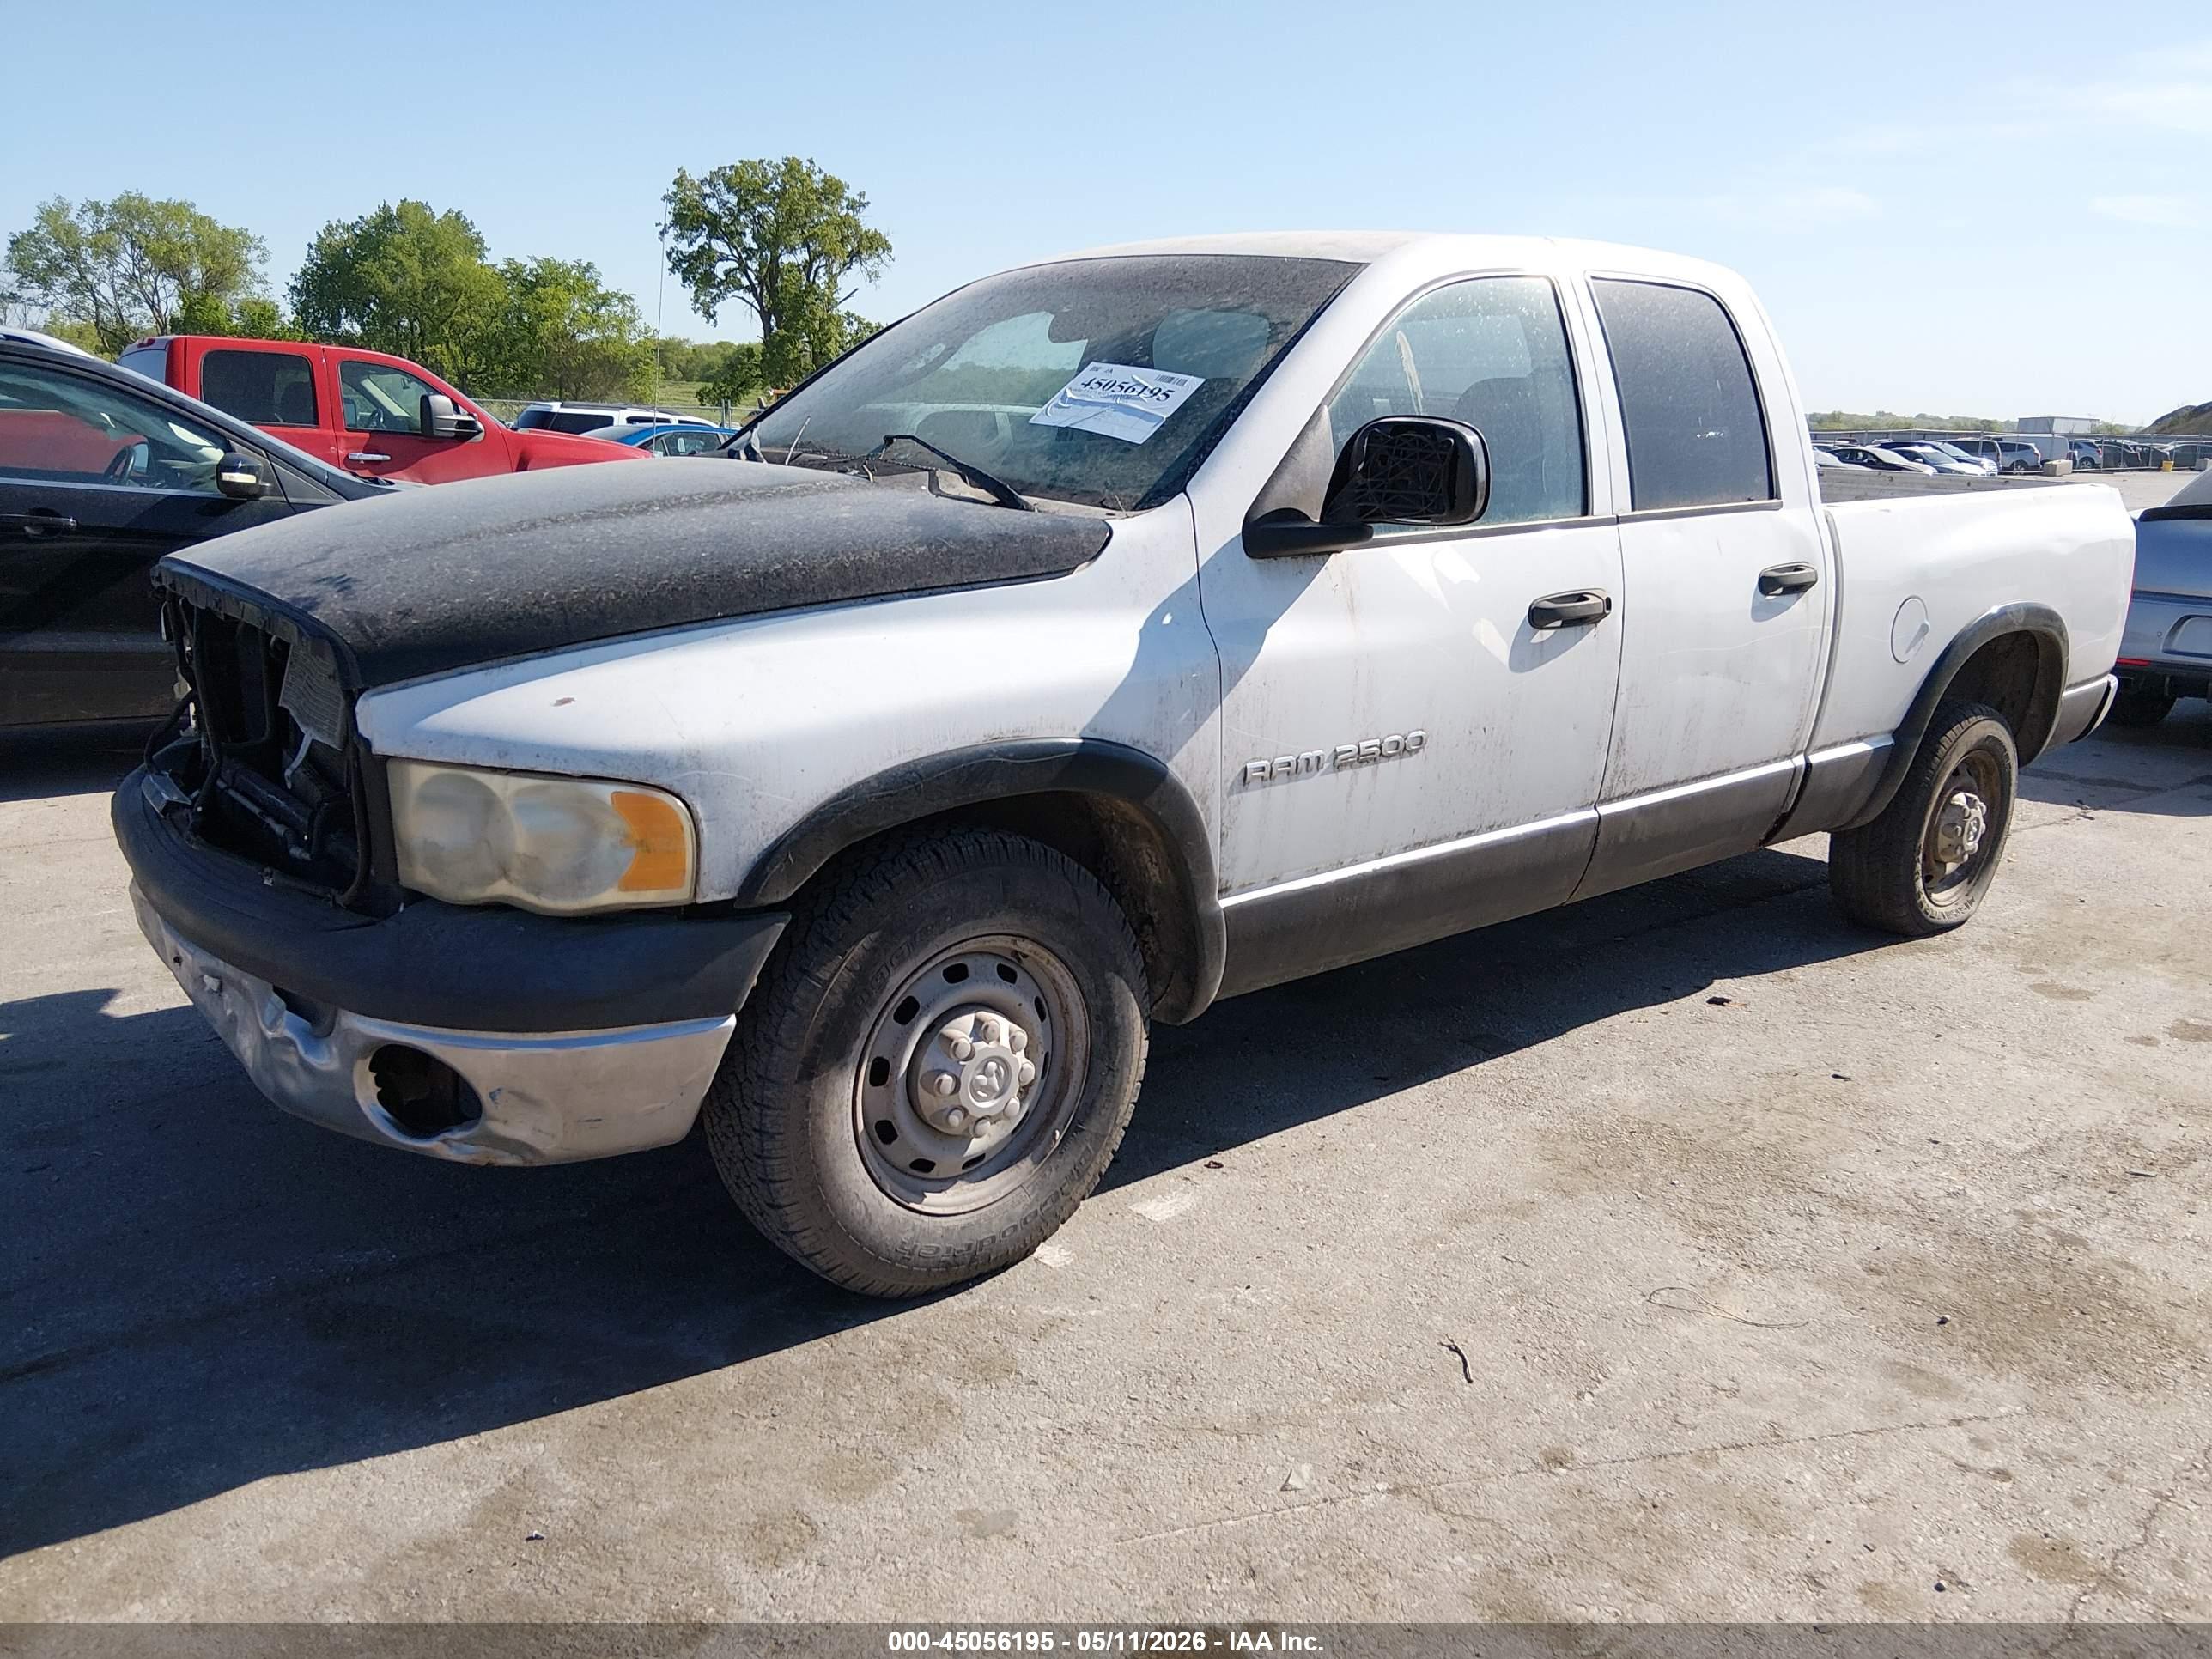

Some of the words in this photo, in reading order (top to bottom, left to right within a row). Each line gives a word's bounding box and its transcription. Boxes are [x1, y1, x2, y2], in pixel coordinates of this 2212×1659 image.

[1081, 377, 1176, 402] 45056195
[1244, 749, 1326, 783] RAM
[1334, 729, 1427, 770] 2500
